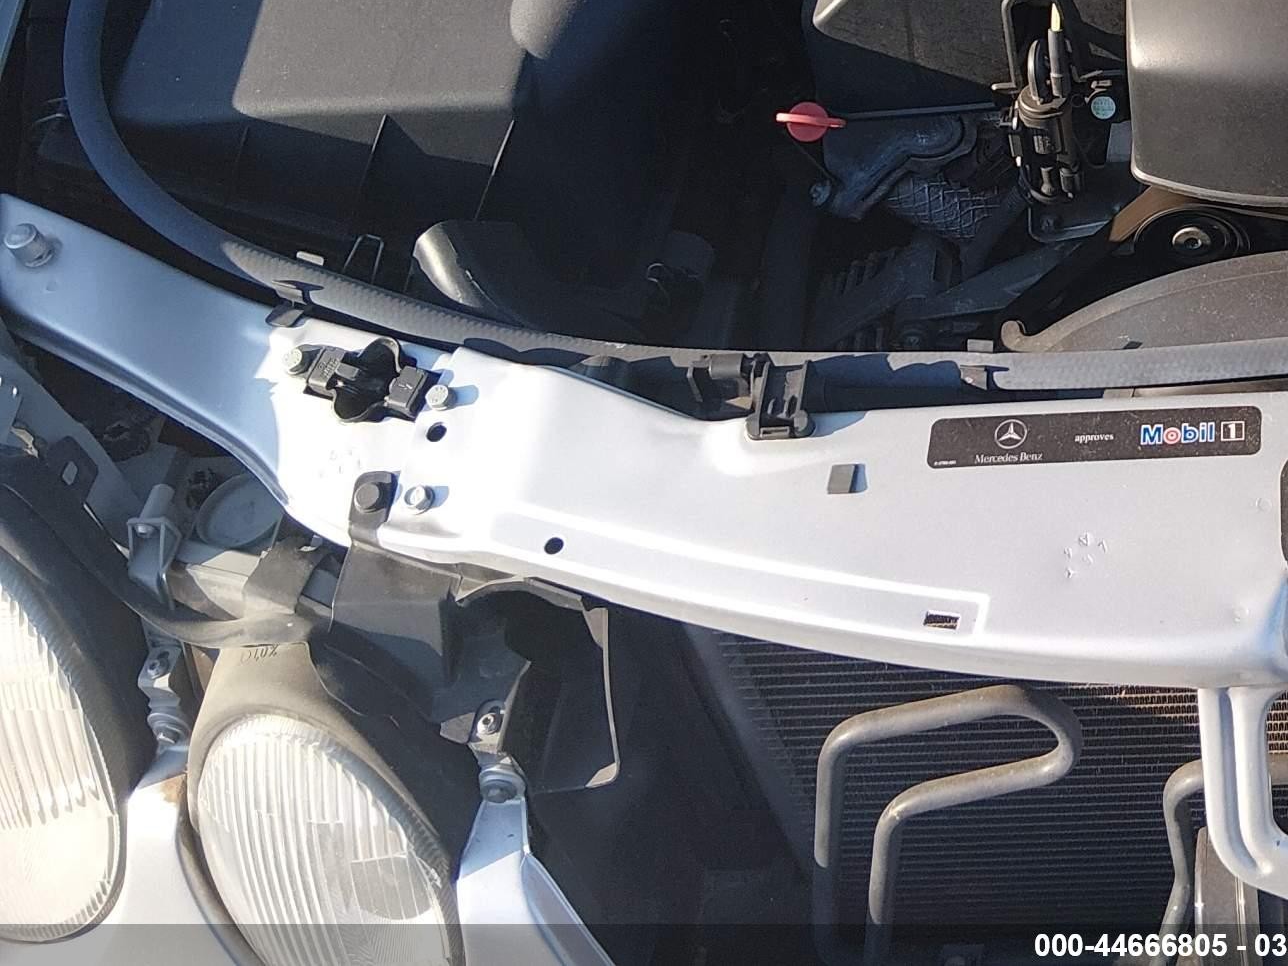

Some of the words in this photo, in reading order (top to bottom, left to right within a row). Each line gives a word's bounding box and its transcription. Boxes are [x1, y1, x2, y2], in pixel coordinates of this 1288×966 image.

[1074, 433, 1115, 444] approves
[1139, 420, 1216, 446] Mobil
[974, 453, 1019, 464] Mercedes
[1019, 451, 1044, 462] Benz
